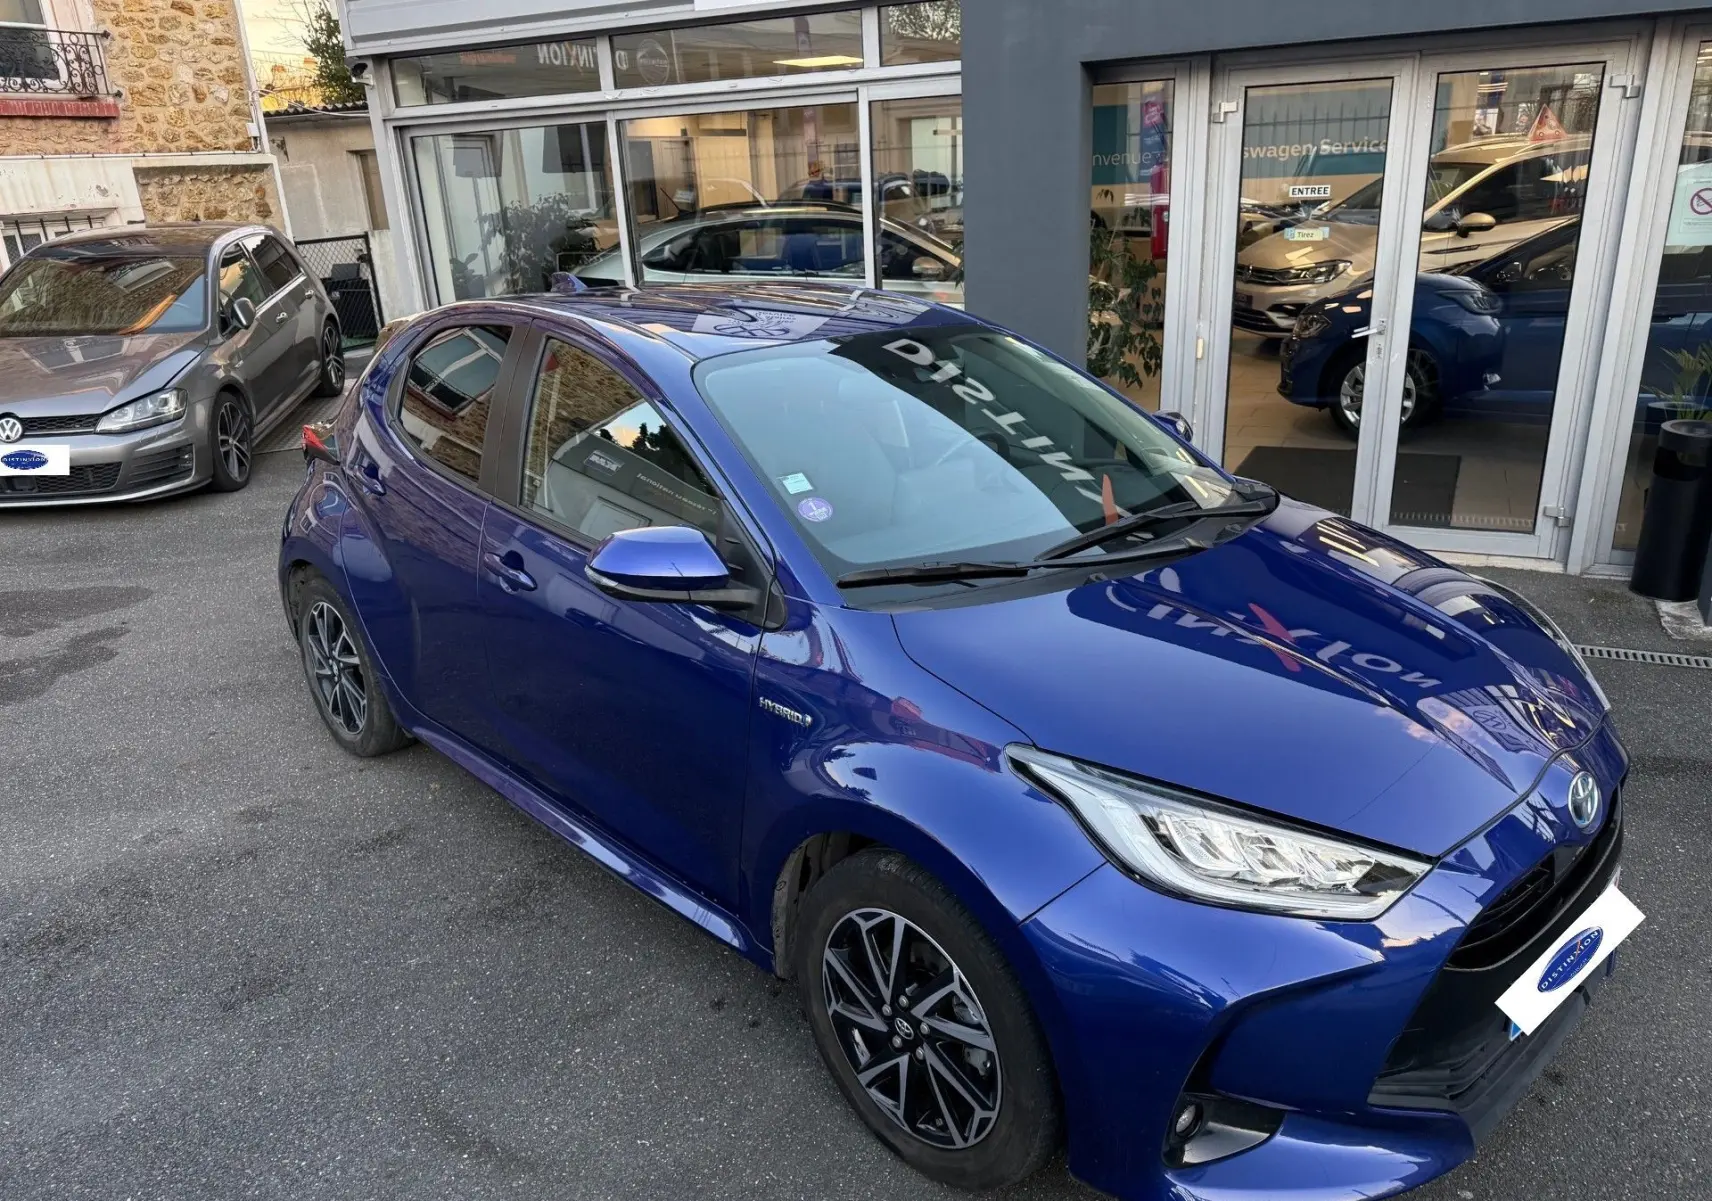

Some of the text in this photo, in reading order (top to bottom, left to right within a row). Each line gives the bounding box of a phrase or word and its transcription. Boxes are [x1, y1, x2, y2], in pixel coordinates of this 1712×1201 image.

[1092, 152, 1152, 166] nvenue
[1244, 143, 1313, 161] swagen
[1291, 186, 1329, 196] ENTREE
[759, 696, 803, 725] HYBRID
